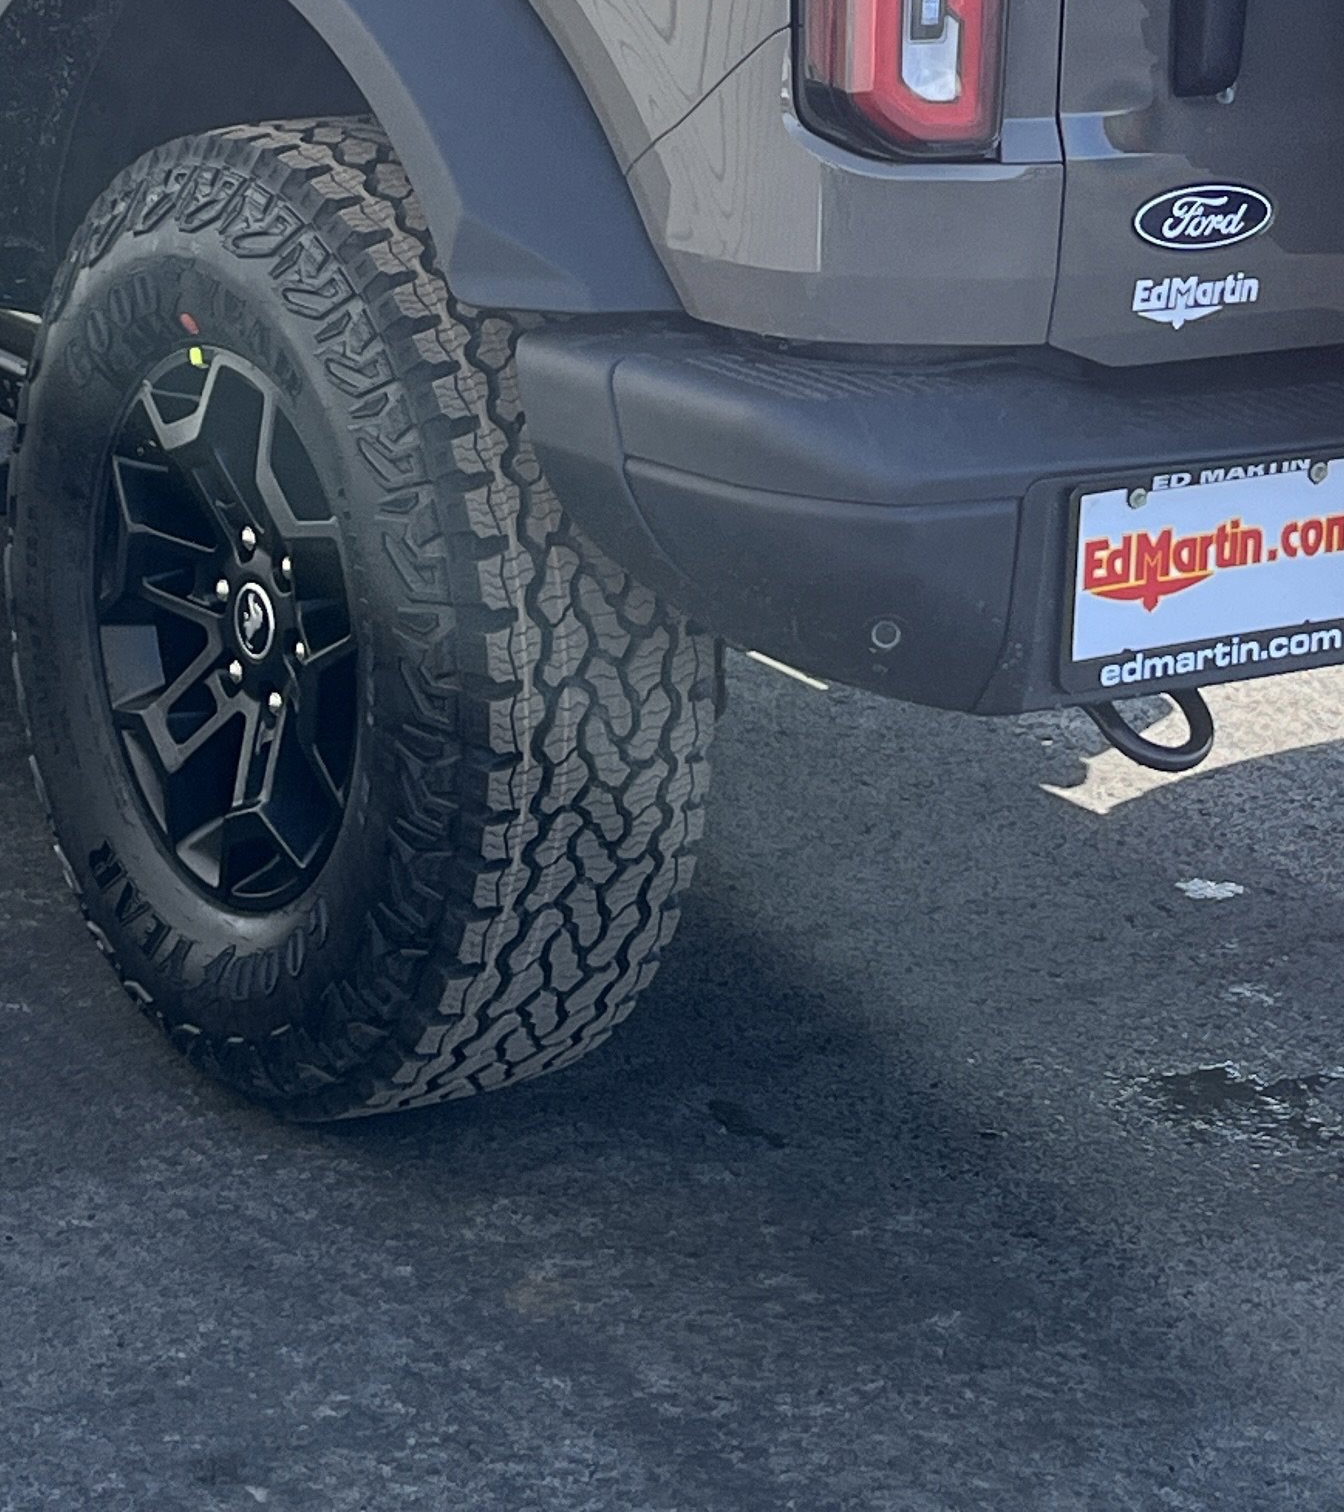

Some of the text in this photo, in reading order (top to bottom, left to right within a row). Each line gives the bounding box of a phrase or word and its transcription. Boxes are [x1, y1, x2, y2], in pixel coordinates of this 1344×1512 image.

[1161, 193, 1249, 238] Ford
[1132, 272, 1260, 329] EdMartin
[1151, 471, 1193, 491] ED
[1099, 624, 1343, 687] edmartin.com
